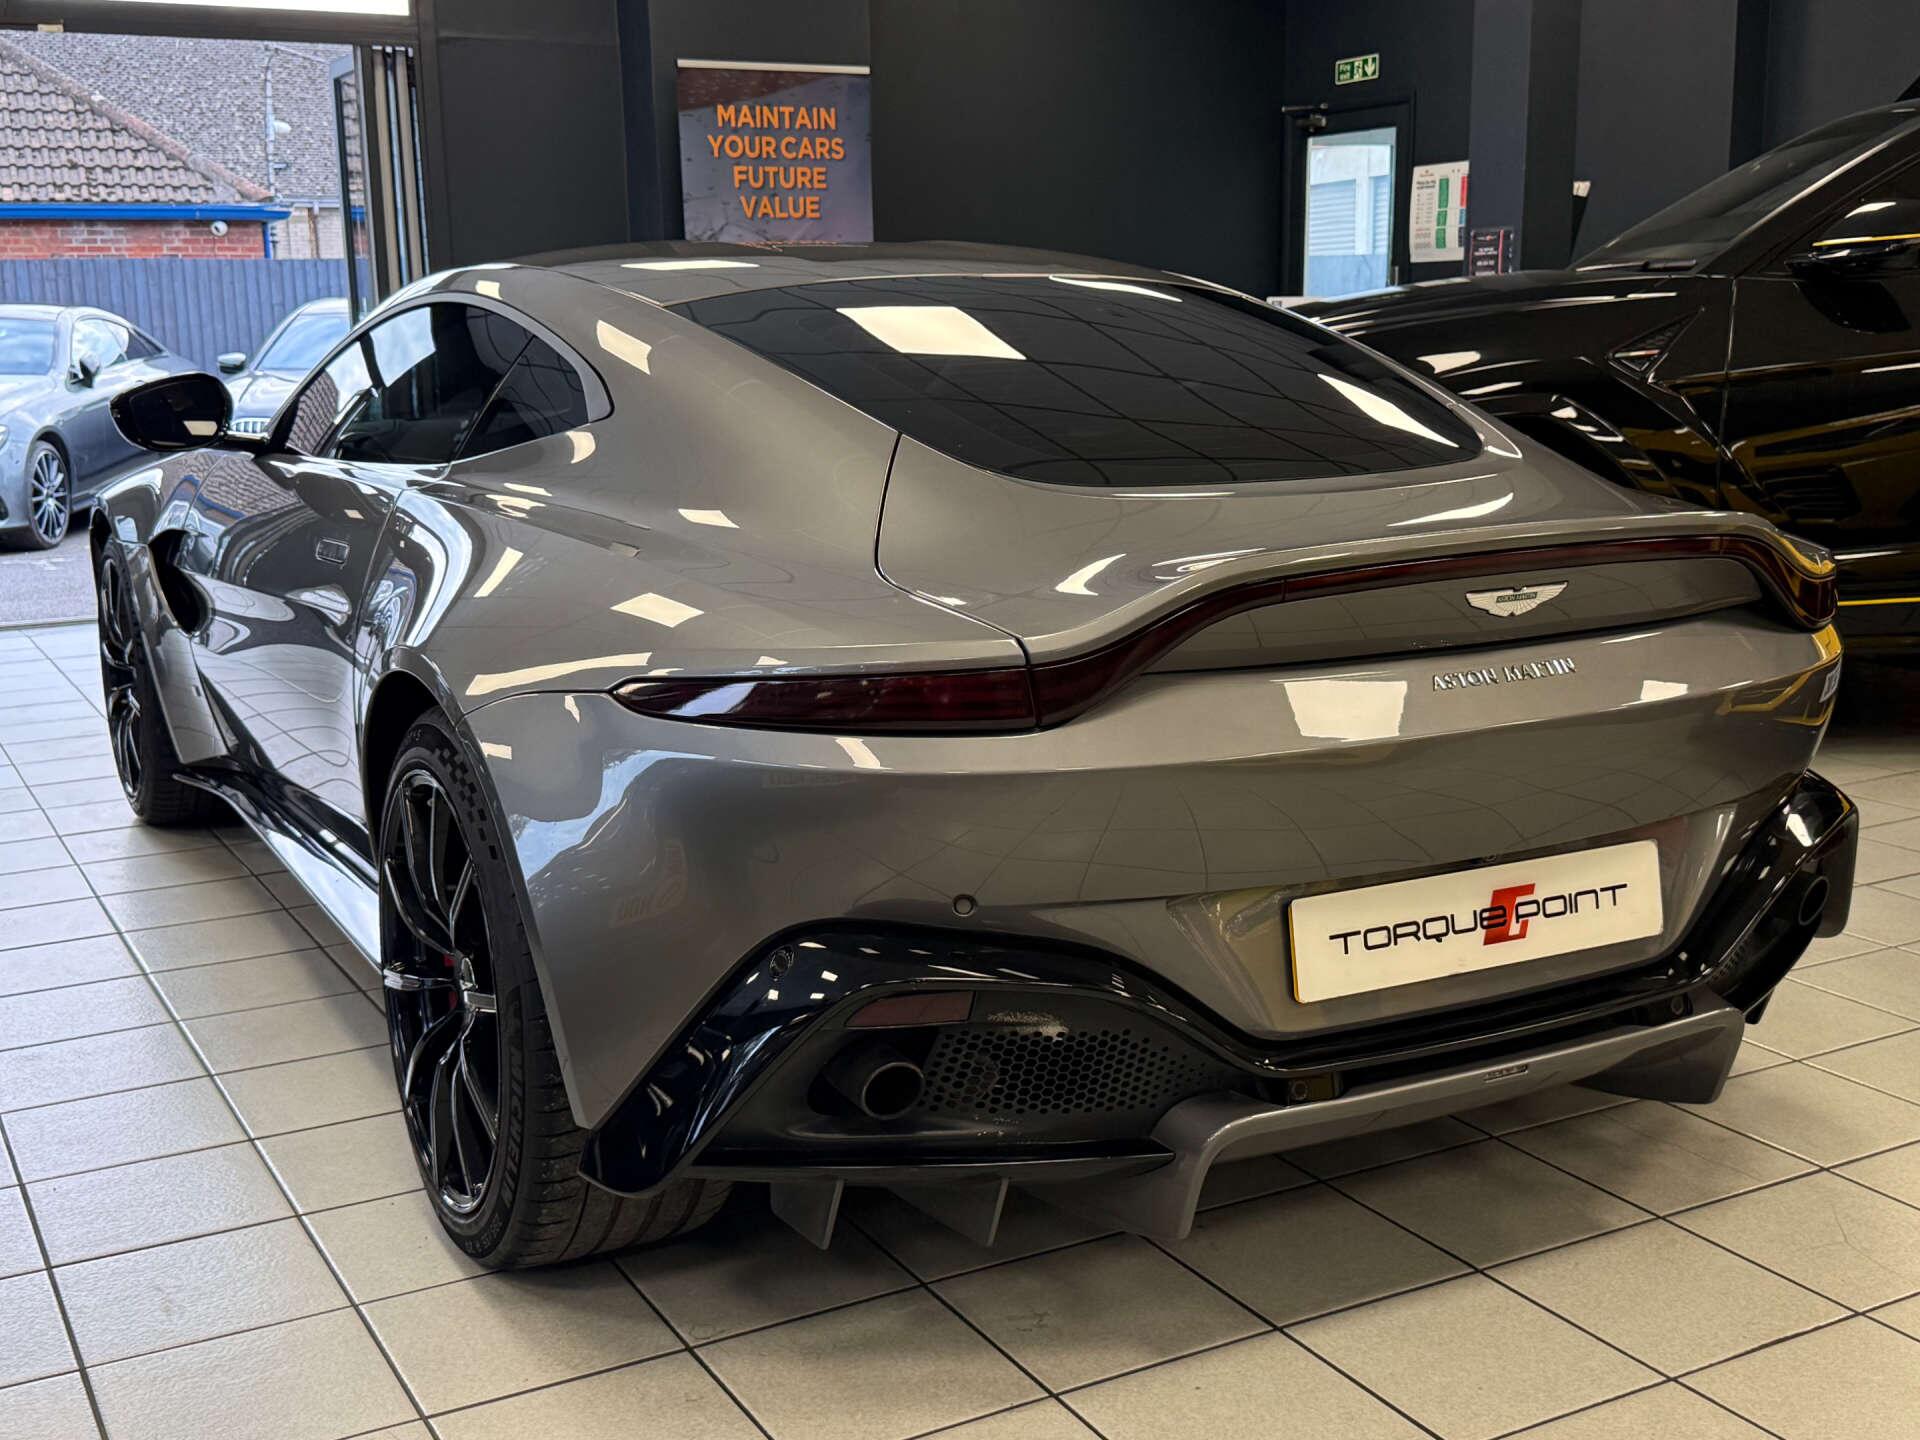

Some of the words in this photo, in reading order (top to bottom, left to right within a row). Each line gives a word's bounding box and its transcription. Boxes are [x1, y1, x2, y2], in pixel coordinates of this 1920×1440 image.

[716, 104, 836, 130] MAINTAIN
[707, 134, 777, 159] YOUR
[780, 136, 845, 161] CARS
[733, 165, 828, 190] FUTURE
[740, 195, 821, 220] VALUE
[1433, 668, 1499, 691] ASTON
[1503, 657, 1577, 683] MARTIN
